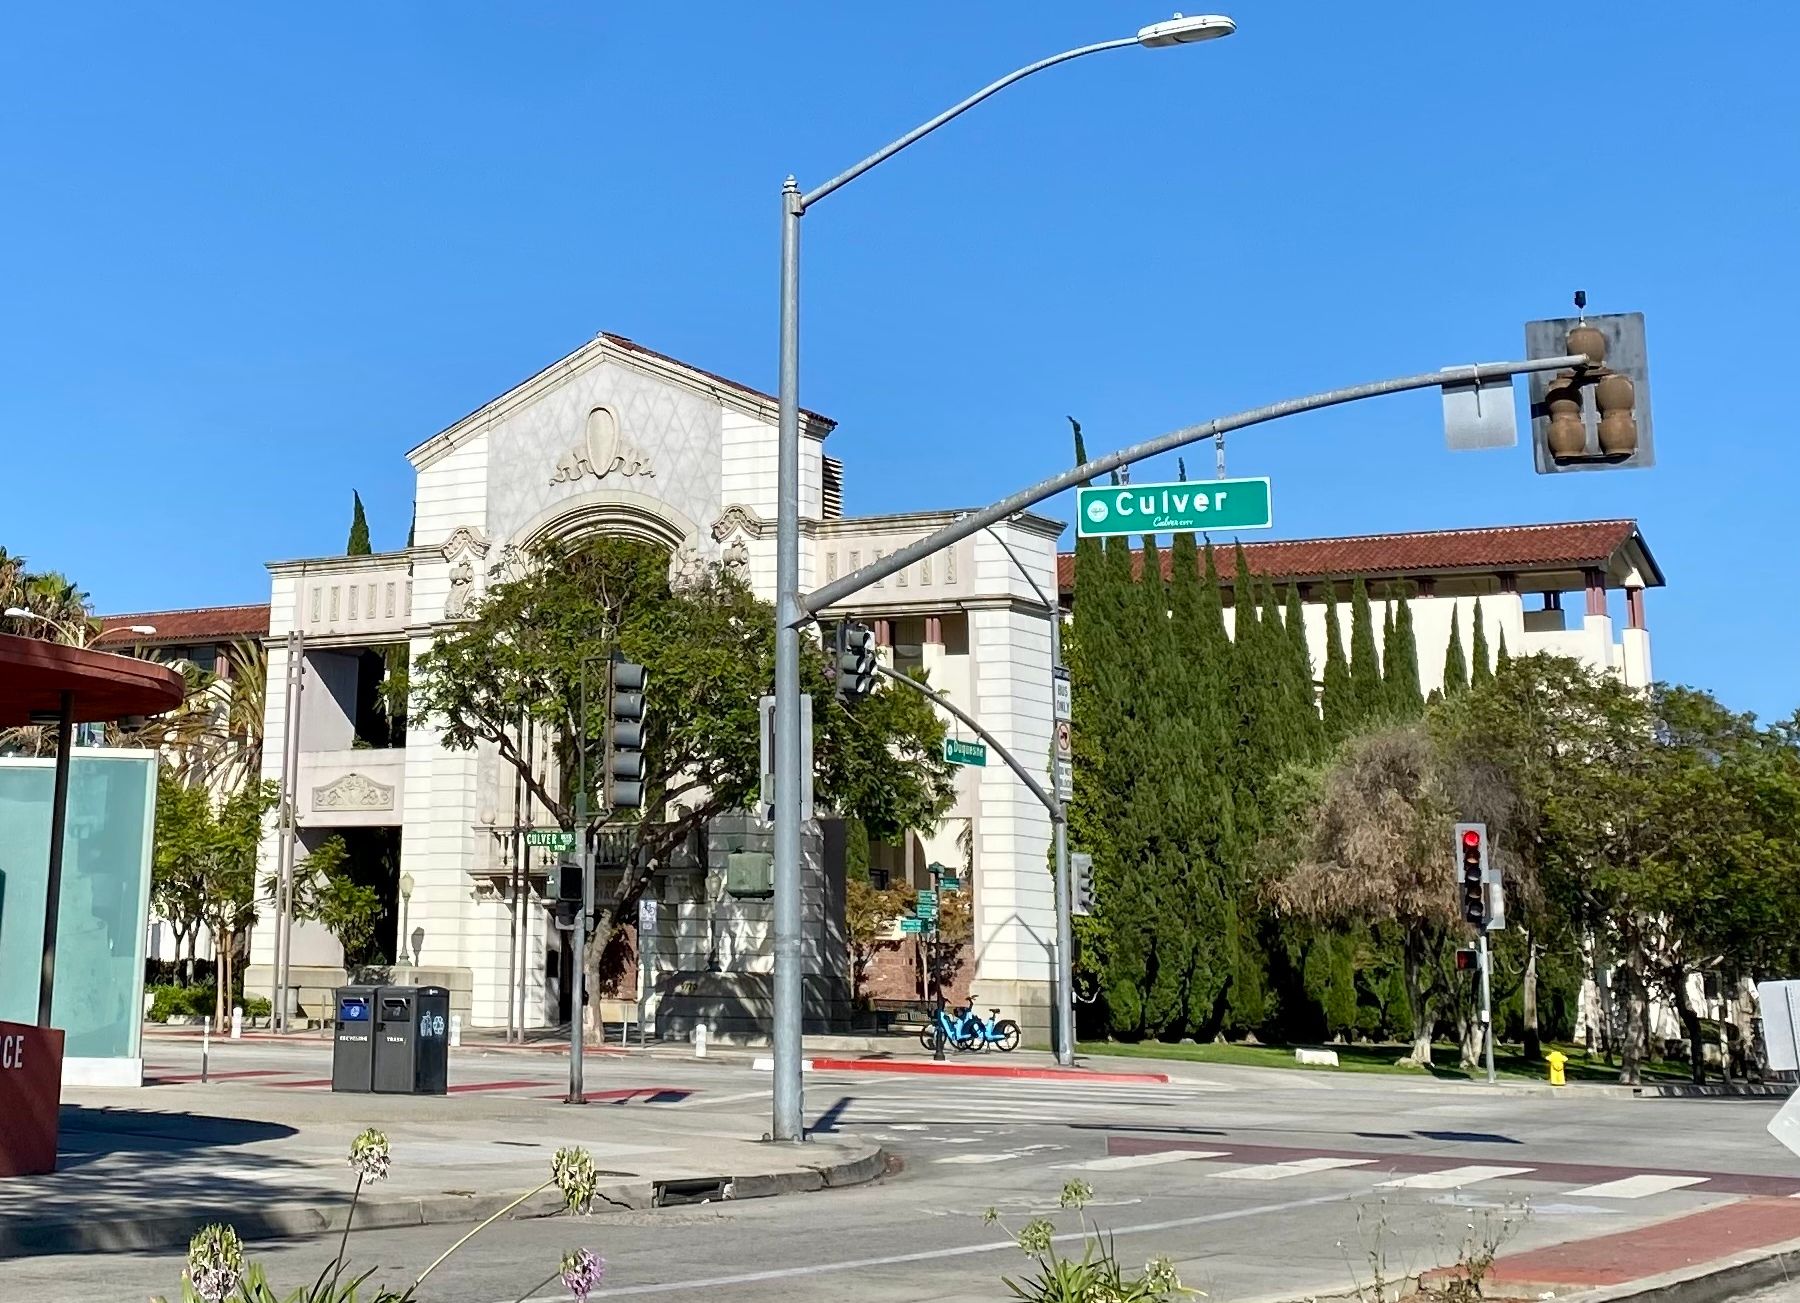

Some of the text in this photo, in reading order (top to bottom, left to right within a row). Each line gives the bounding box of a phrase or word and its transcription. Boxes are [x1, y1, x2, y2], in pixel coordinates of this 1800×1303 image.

[1115, 490, 1228, 516] Culver
[1152, 516, 1179, 527] Culver
[1057, 684, 1068, 697] BUS
[1056, 700, 1069, 713] ONLY
[953, 740, 984, 757] Duquesne
[526, 833, 557, 845] CULVER
[0, 1035, 24, 1069] CE
